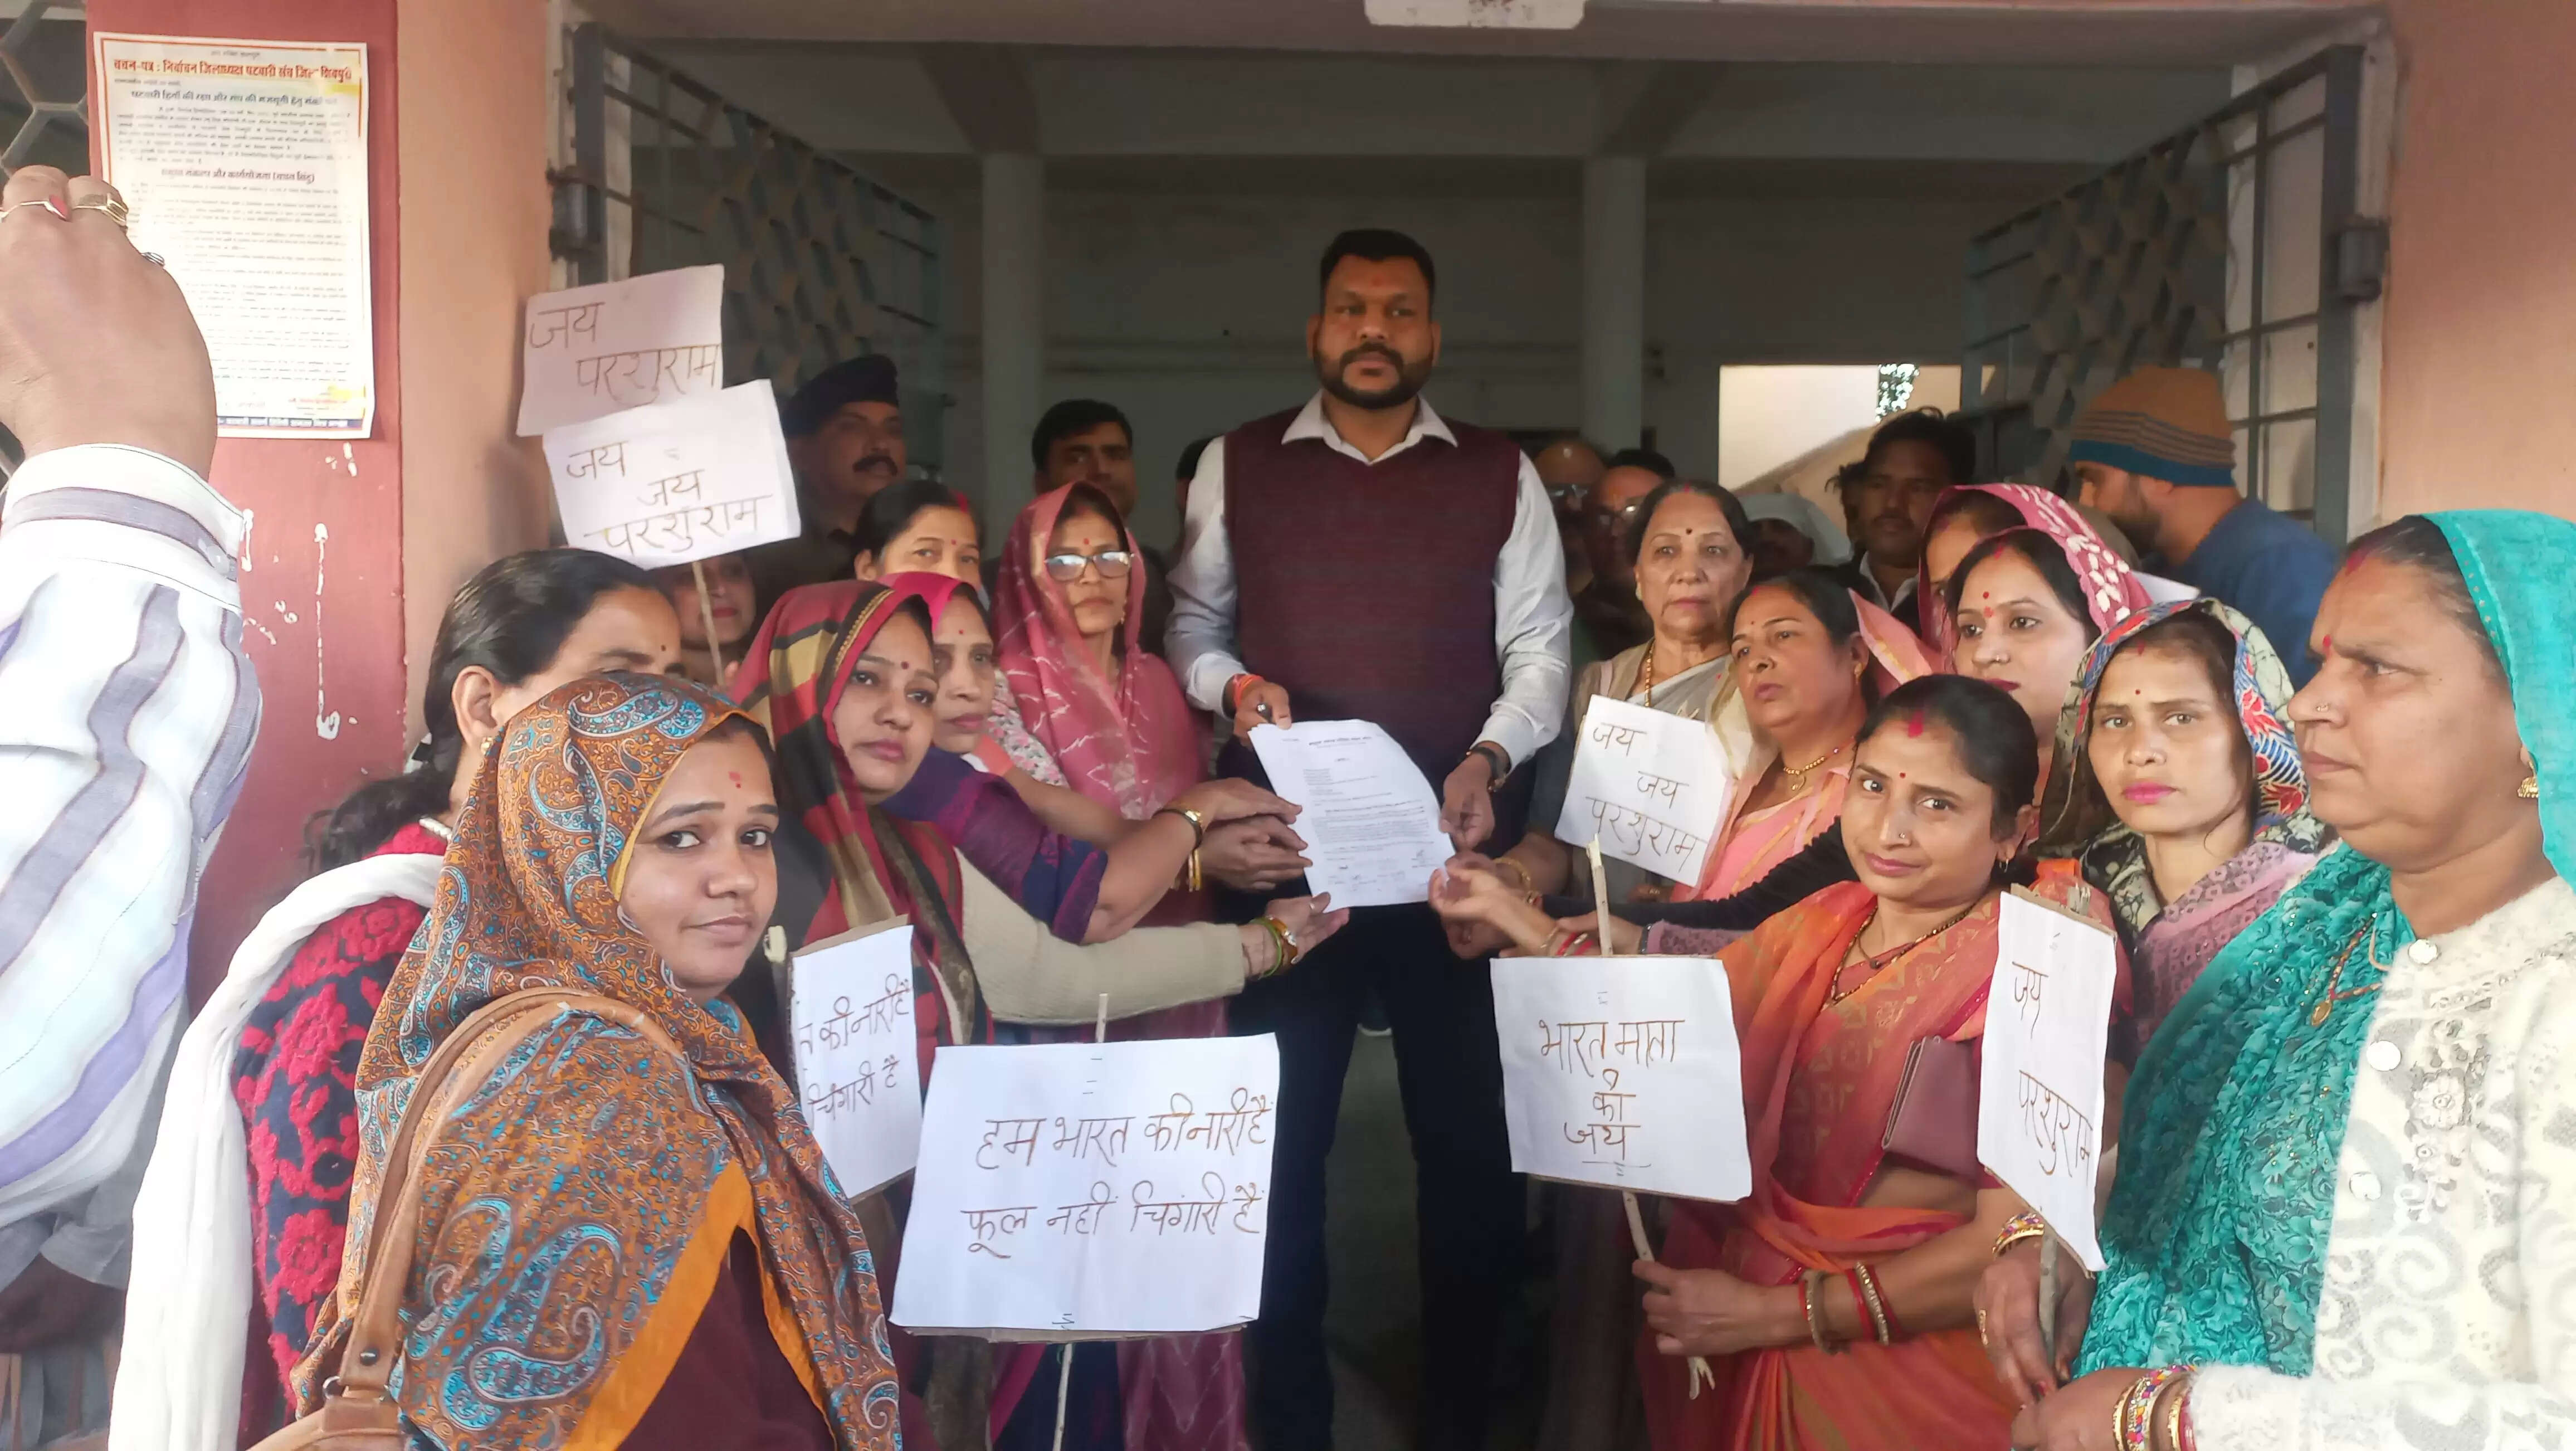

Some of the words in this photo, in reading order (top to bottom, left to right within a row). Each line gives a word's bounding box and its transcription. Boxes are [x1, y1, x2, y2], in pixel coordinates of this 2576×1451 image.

[529, 301, 606, 349] जय
[567, 440, 629, 479] जय
[637, 469, 705, 507] जय
[583, 494, 773, 556] परशुराम
[1593, 722, 1647, 757] जय
[1637, 771, 1690, 810] जय
[1585, 796, 1709, 874] परशुराम
[2012, 961, 2048, 1039] जय
[1539, 1020, 1609, 1078] भारत
[1615, 1020, 1685, 1069] माता
[975, 1118, 1047, 1170] हम
[1052, 1116, 1136, 1167] भारत
[1144, 1093, 1196, 1151] की
[1564, 1122, 1641, 1161] जय
[2018, 1069, 2093, 1186] परशुराम
[960, 1206, 1038, 1259] फूल
[1046, 1181, 1119, 1236] नहीं
